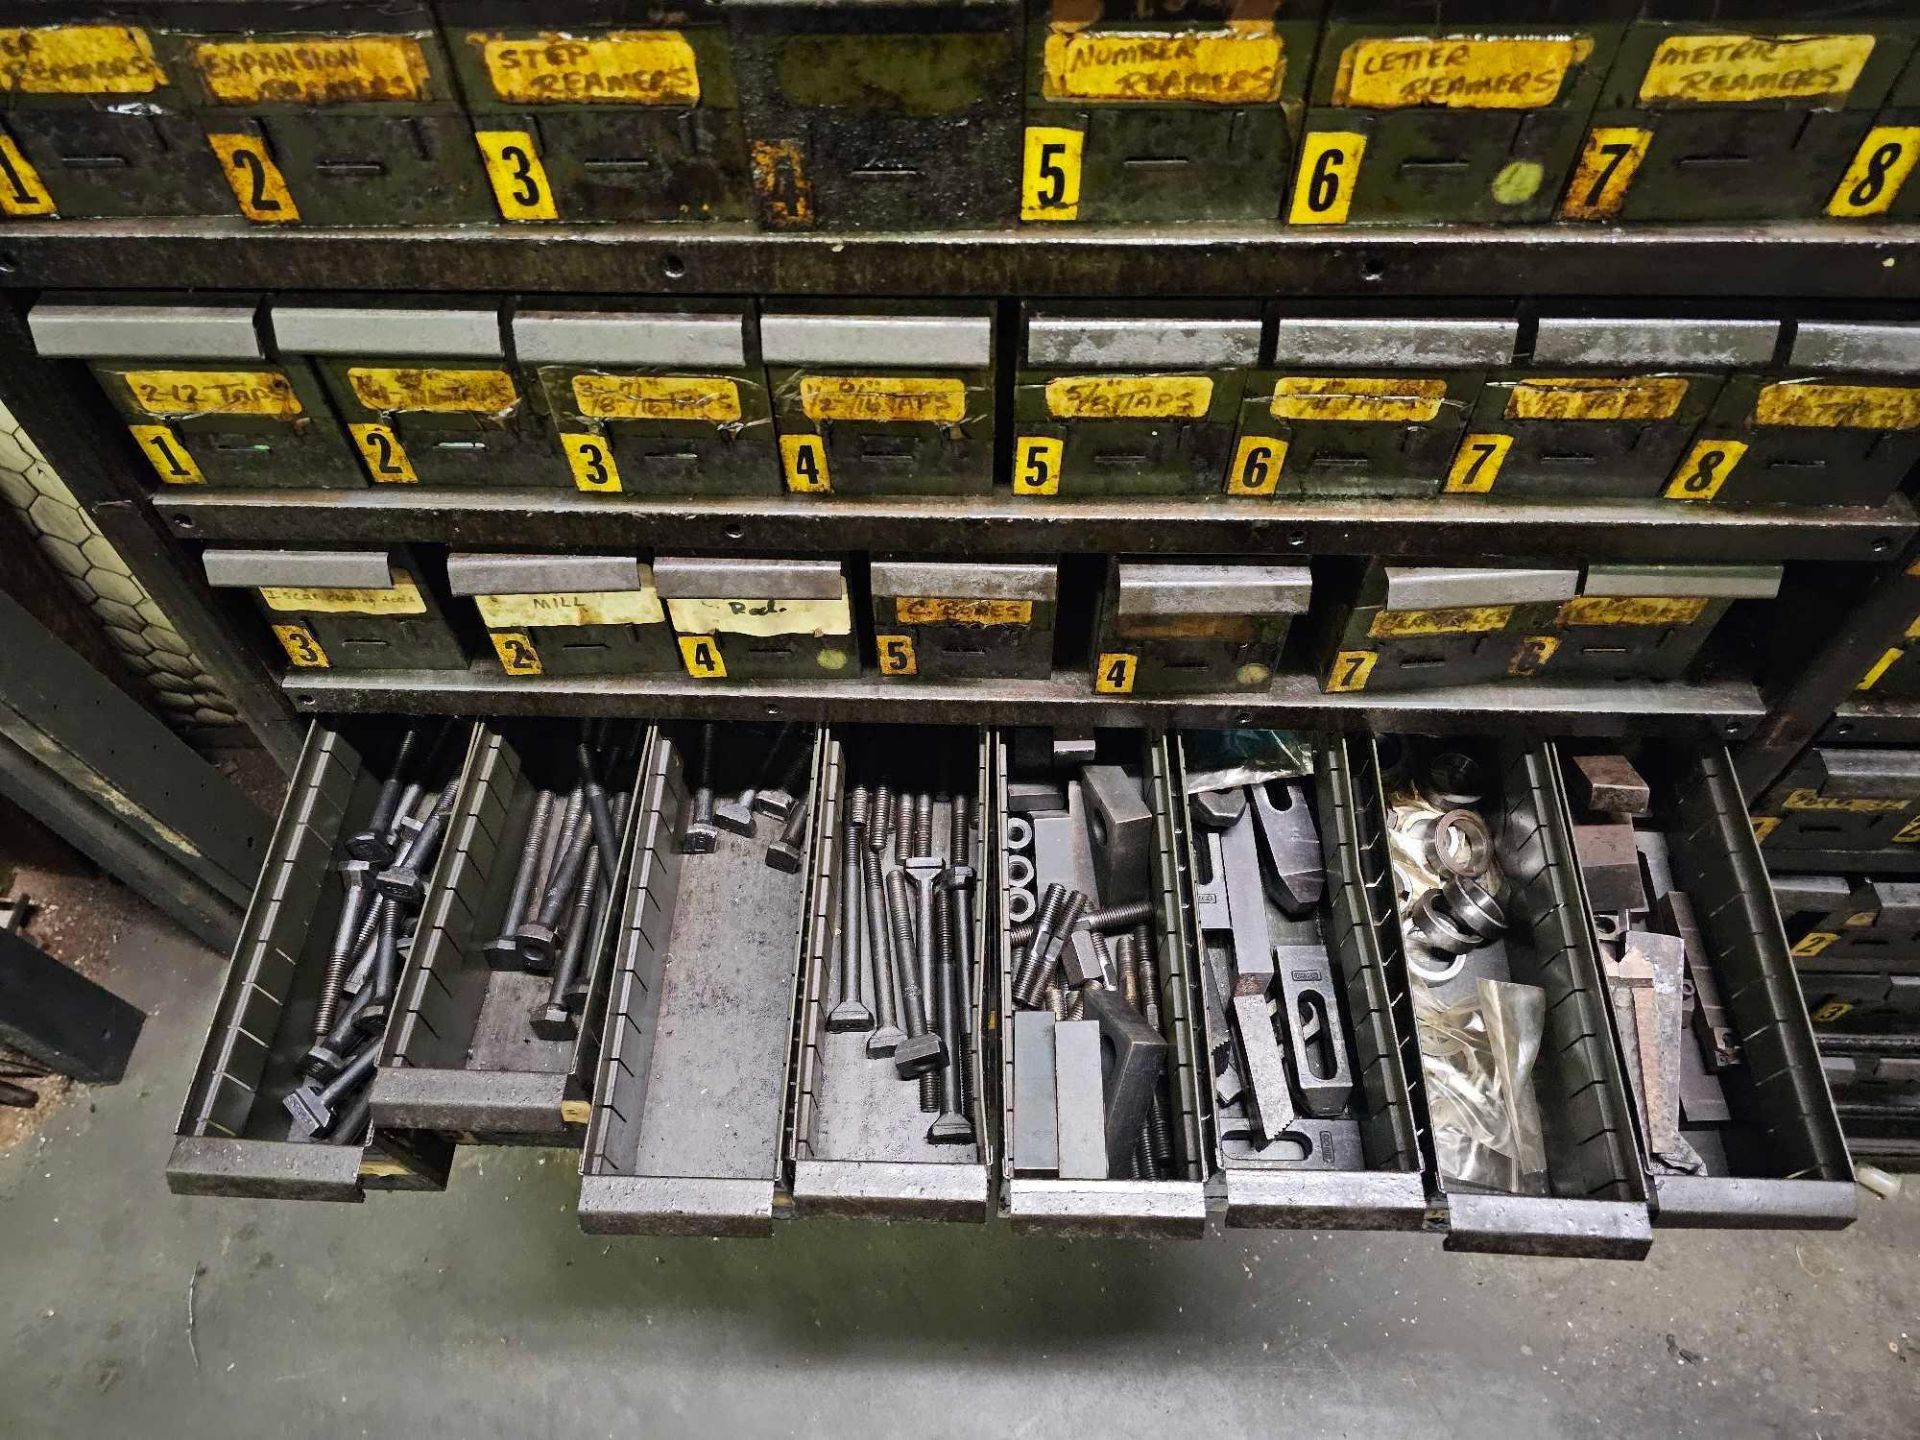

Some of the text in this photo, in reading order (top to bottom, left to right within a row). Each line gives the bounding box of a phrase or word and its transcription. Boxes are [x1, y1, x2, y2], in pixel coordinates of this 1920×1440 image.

[206, 48, 359, 77] EXPANSION
[498, 43, 588, 69] STEP
[1363, 45, 1470, 74] LETTER
[529, 67, 693, 94] REAMERS
[1115, 66, 1271, 96] REAMERS
[1400, 69, 1557, 98] REAMERS
[1679, 65, 1843, 93] REAMERS
[0, 152, 40, 204] 1
[233, 150, 281, 211] 2
[503, 147, 540, 207] 3
[1037, 144, 1067, 207] 5
[1308, 148, 1344, 212] 6
[1584, 143, 1633, 207] 7
[1848, 143, 1902, 206] 8
[151, 435, 191, 475] 1
[366, 433, 403, 473] 2
[580, 444, 609, 485] 3
[797, 445, 820, 485] 4
[1024, 446, 1049, 487] 5
[1242, 447, 1272, 488] 6
[1461, 444, 1497, 484] 7
[1684, 450, 1725, 493] 8
[534, 597, 587, 610] MILL
[289, 634, 318, 663] 3
[504, 640, 534, 669] 2
[696, 643, 715, 672] 4
[888, 641, 908, 670] 5
[1107, 660, 1127, 688] 4
[1341, 657, 1366, 687] 7
[1796, 936, 1827, 953] 2
